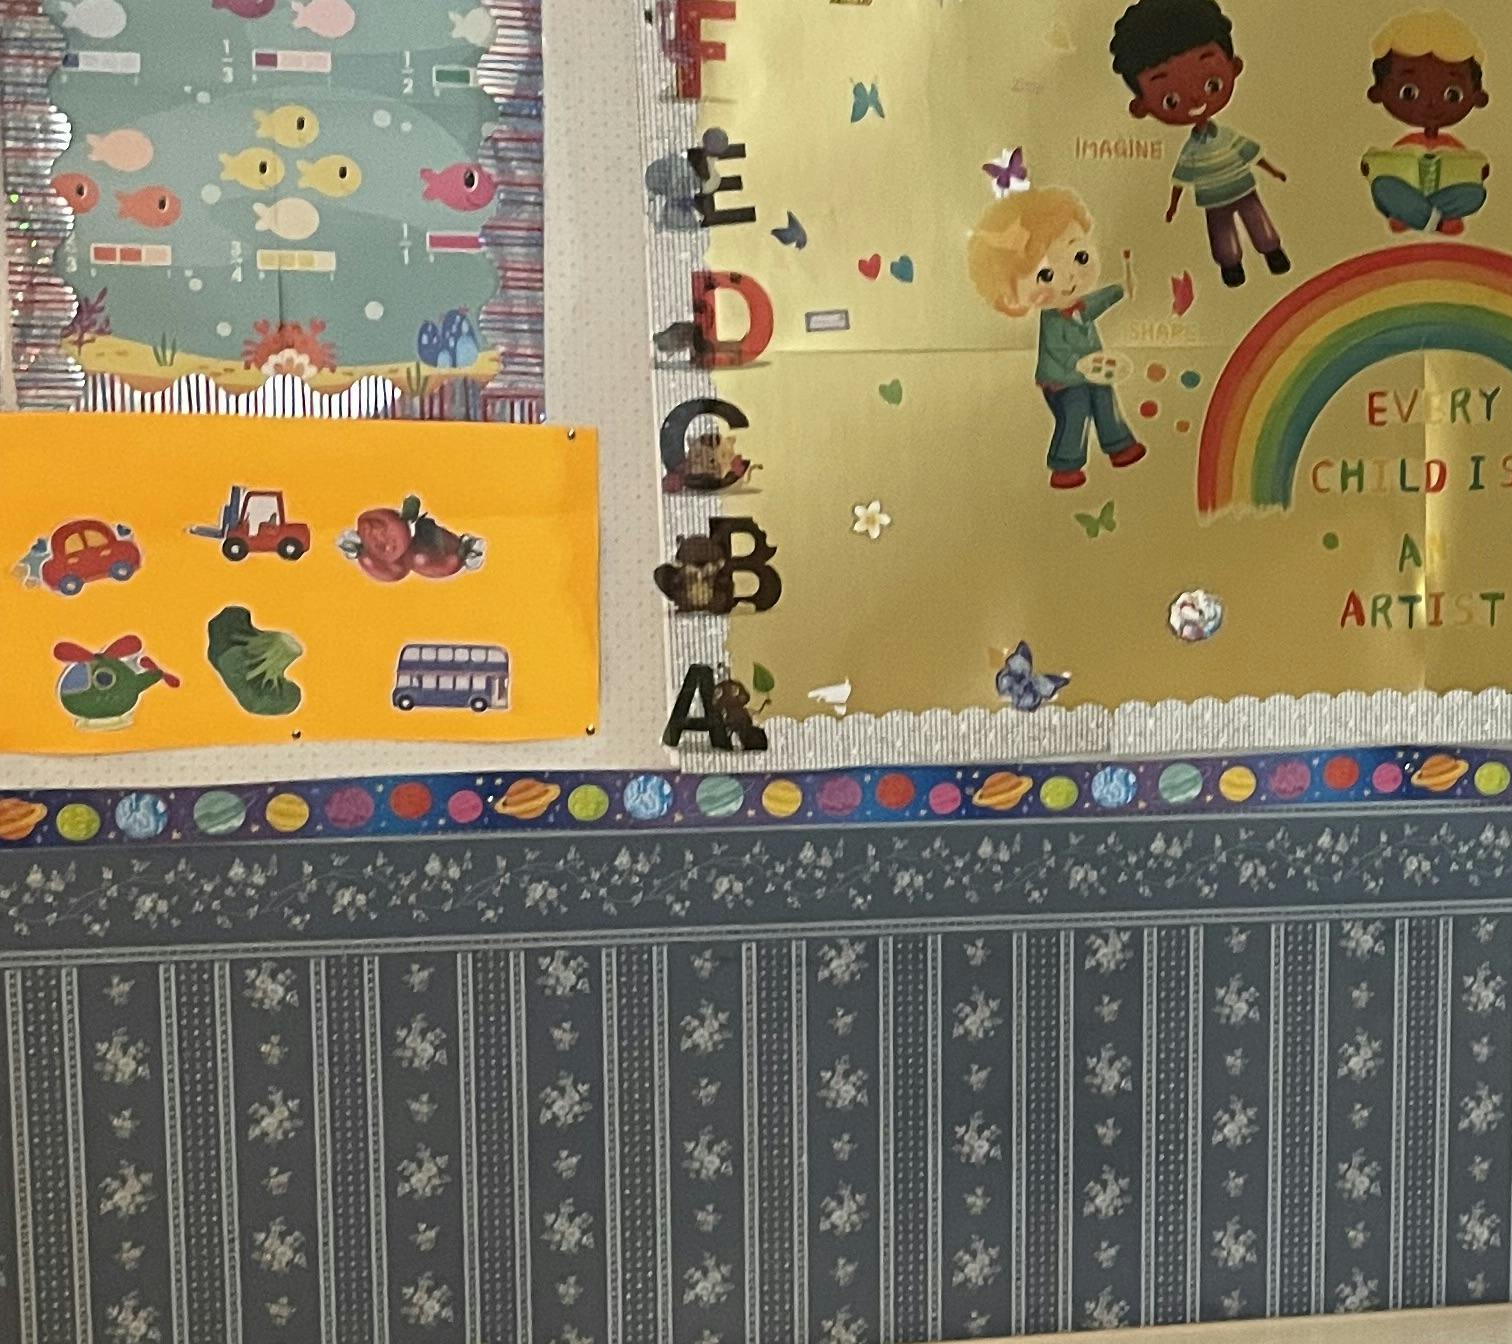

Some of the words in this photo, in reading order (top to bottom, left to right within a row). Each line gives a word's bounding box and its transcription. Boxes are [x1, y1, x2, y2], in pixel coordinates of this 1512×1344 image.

[687, 142, 757, 228] E
[1074, 135, 1165, 160] IMAGINE
[691, 270, 775, 369] D
[659, 397, 751, 490] C
[1367, 385, 1501, 427] EVERY
[1311, 457, 1447, 494] CHILD
[706, 516, 783, 613] B
[1340, 589, 1506, 630] ARTIST
[661, 663, 738, 749] A
